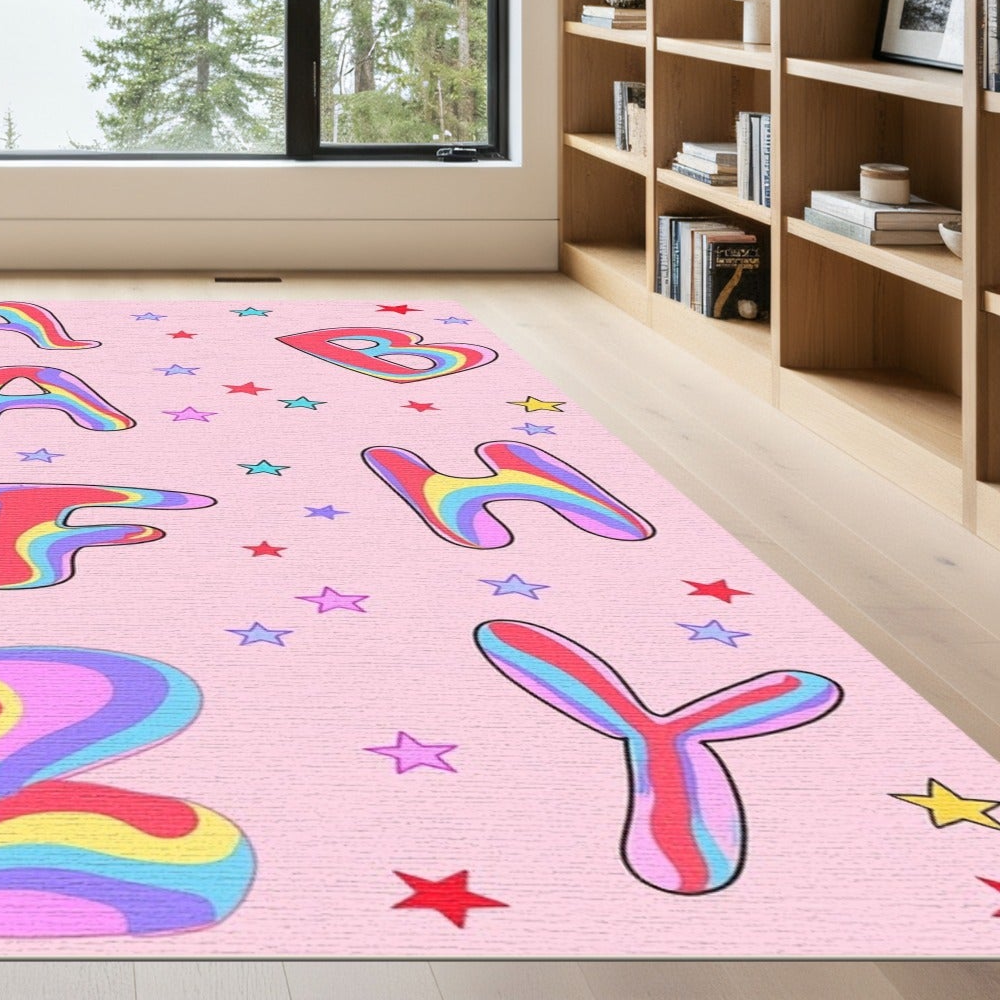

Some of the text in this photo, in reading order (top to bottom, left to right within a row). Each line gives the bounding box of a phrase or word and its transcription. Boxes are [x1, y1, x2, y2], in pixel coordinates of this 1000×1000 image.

[275, 327, 499, 384] B
[361, 440, 656, 550] H
[473, 619, 845, 895] Y
